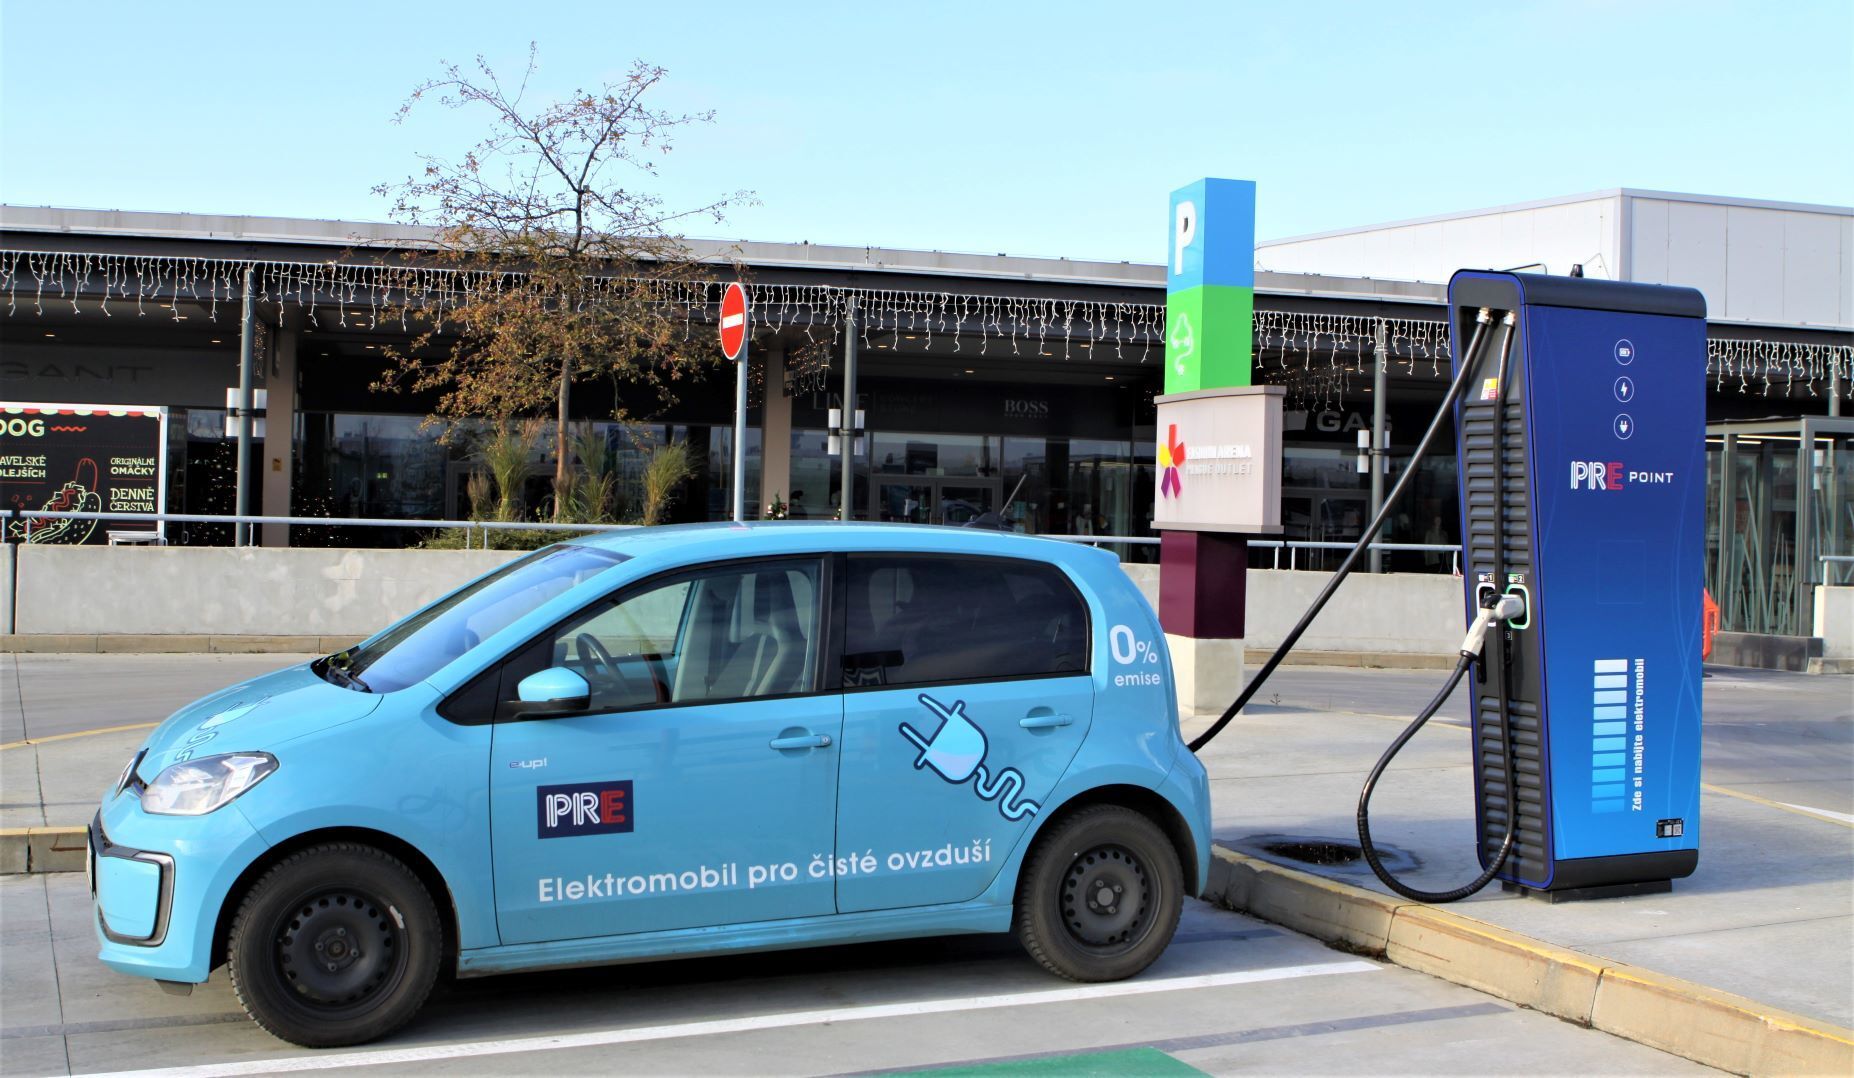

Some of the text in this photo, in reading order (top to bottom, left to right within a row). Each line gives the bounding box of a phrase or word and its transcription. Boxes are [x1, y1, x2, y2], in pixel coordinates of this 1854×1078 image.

[1174, 201, 1196, 276] P
[1004, 399, 1049, 413] BOSS
[110, 464, 155, 475] OMÁČKY
[1570, 461, 1674, 490] PRE POINT
[110, 486, 154, 500] DENNĚ
[1110, 625, 1158, 665] 0%
[1114, 672, 1161, 687] emise
[1632, 658, 1645, 811] Zde si nabijte elektromobil
[545, 790, 626, 828] PRE
[538, 838, 991, 902] Elektromobil pro čisté ovzduší
